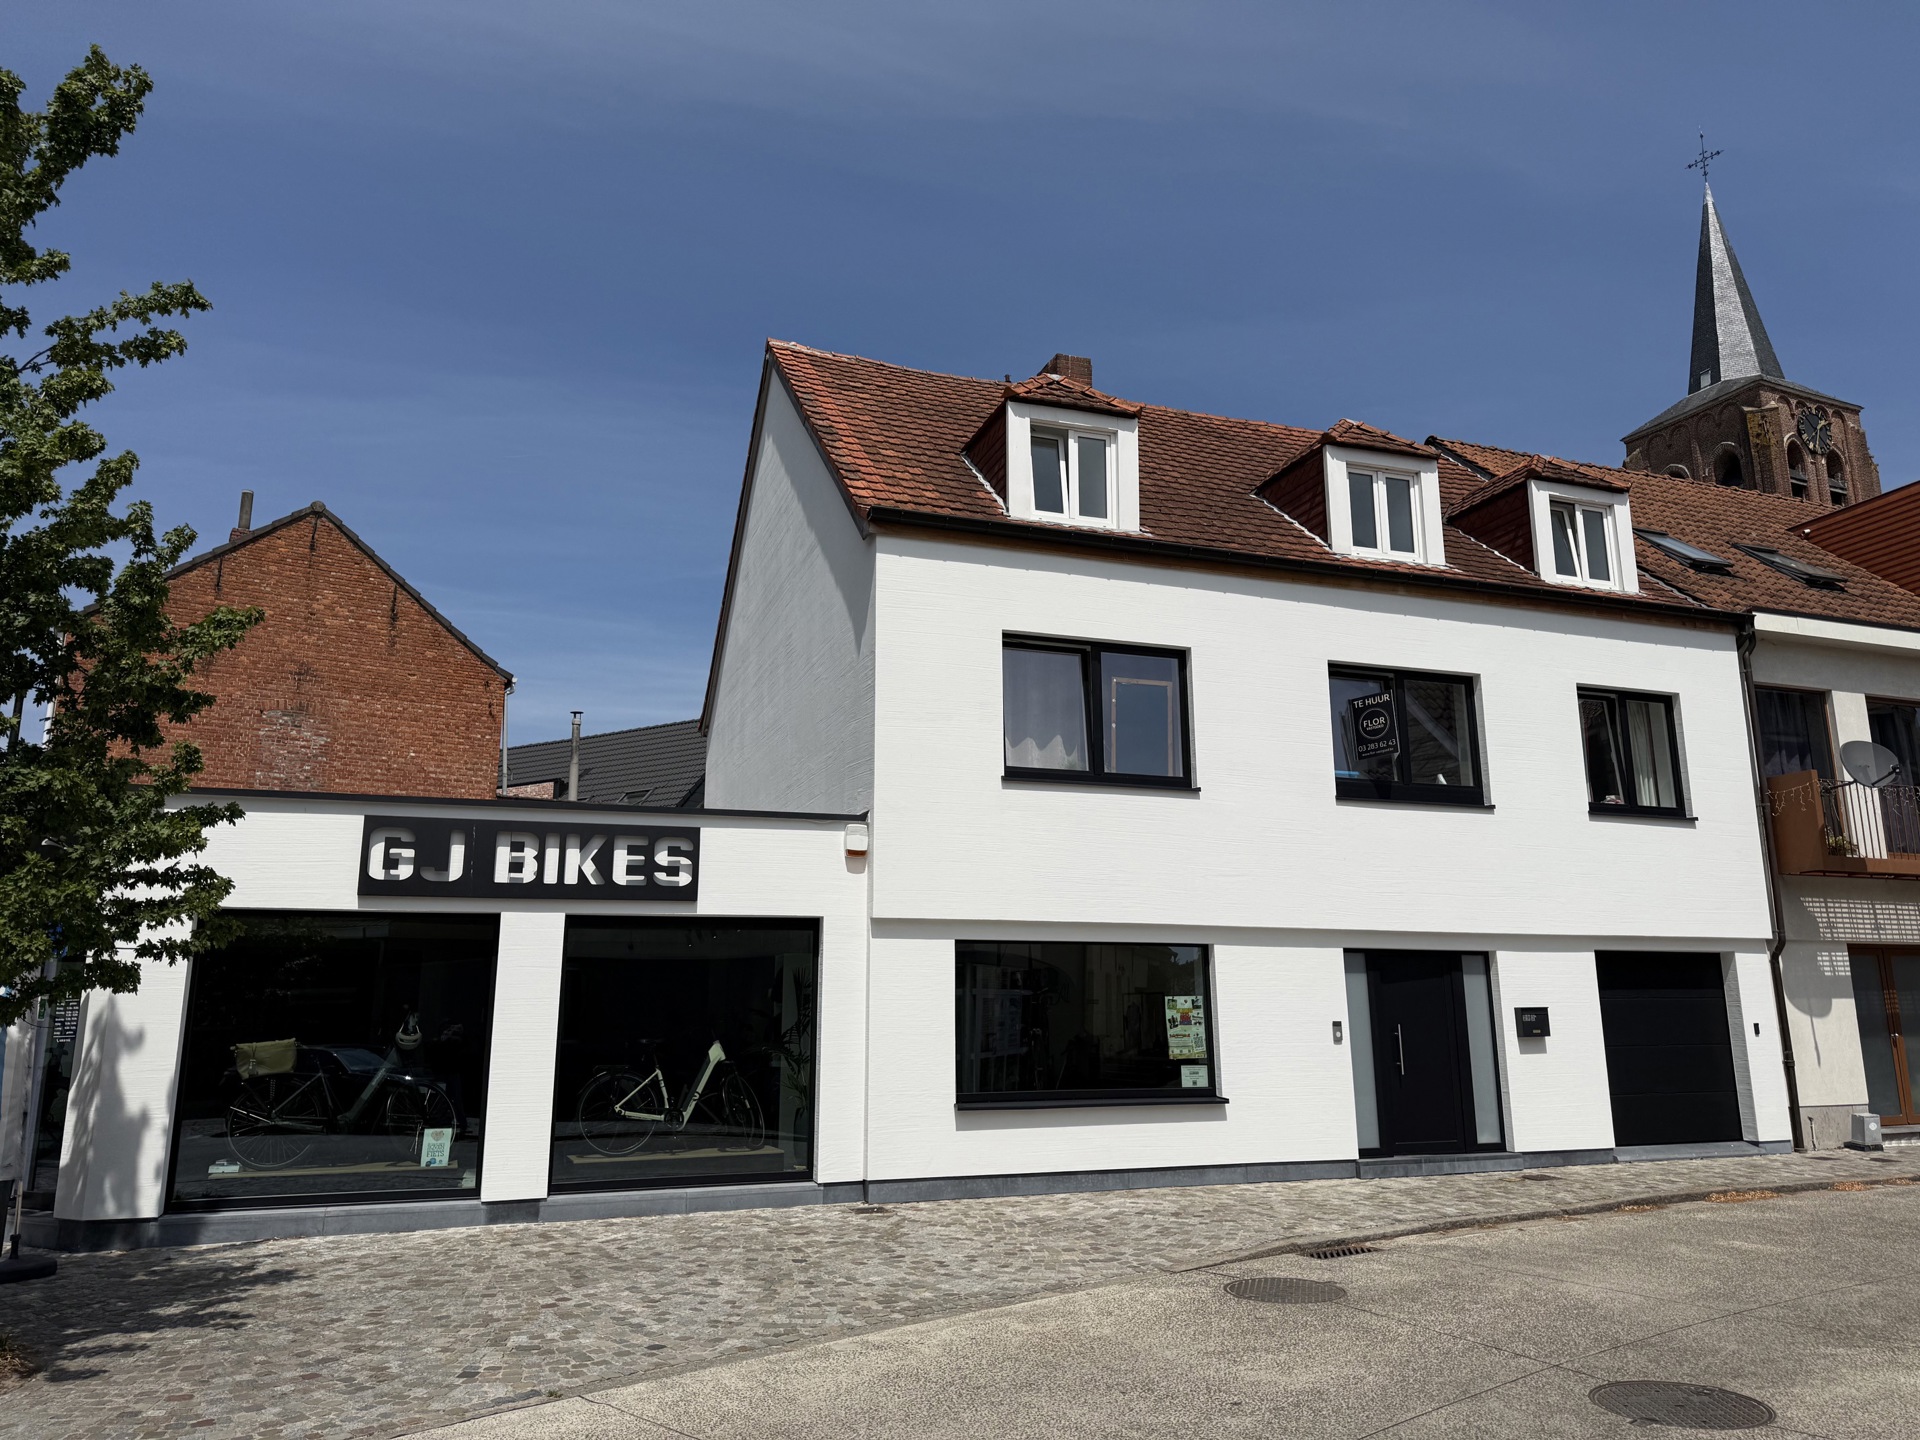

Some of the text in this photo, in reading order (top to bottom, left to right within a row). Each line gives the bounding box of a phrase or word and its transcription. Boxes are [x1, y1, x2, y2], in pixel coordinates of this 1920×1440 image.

[1353, 694, 1390, 708] TE HUUR
[1364, 717, 1385, 727] FLOR
[366, 826, 694, 887] GJ BIKES
